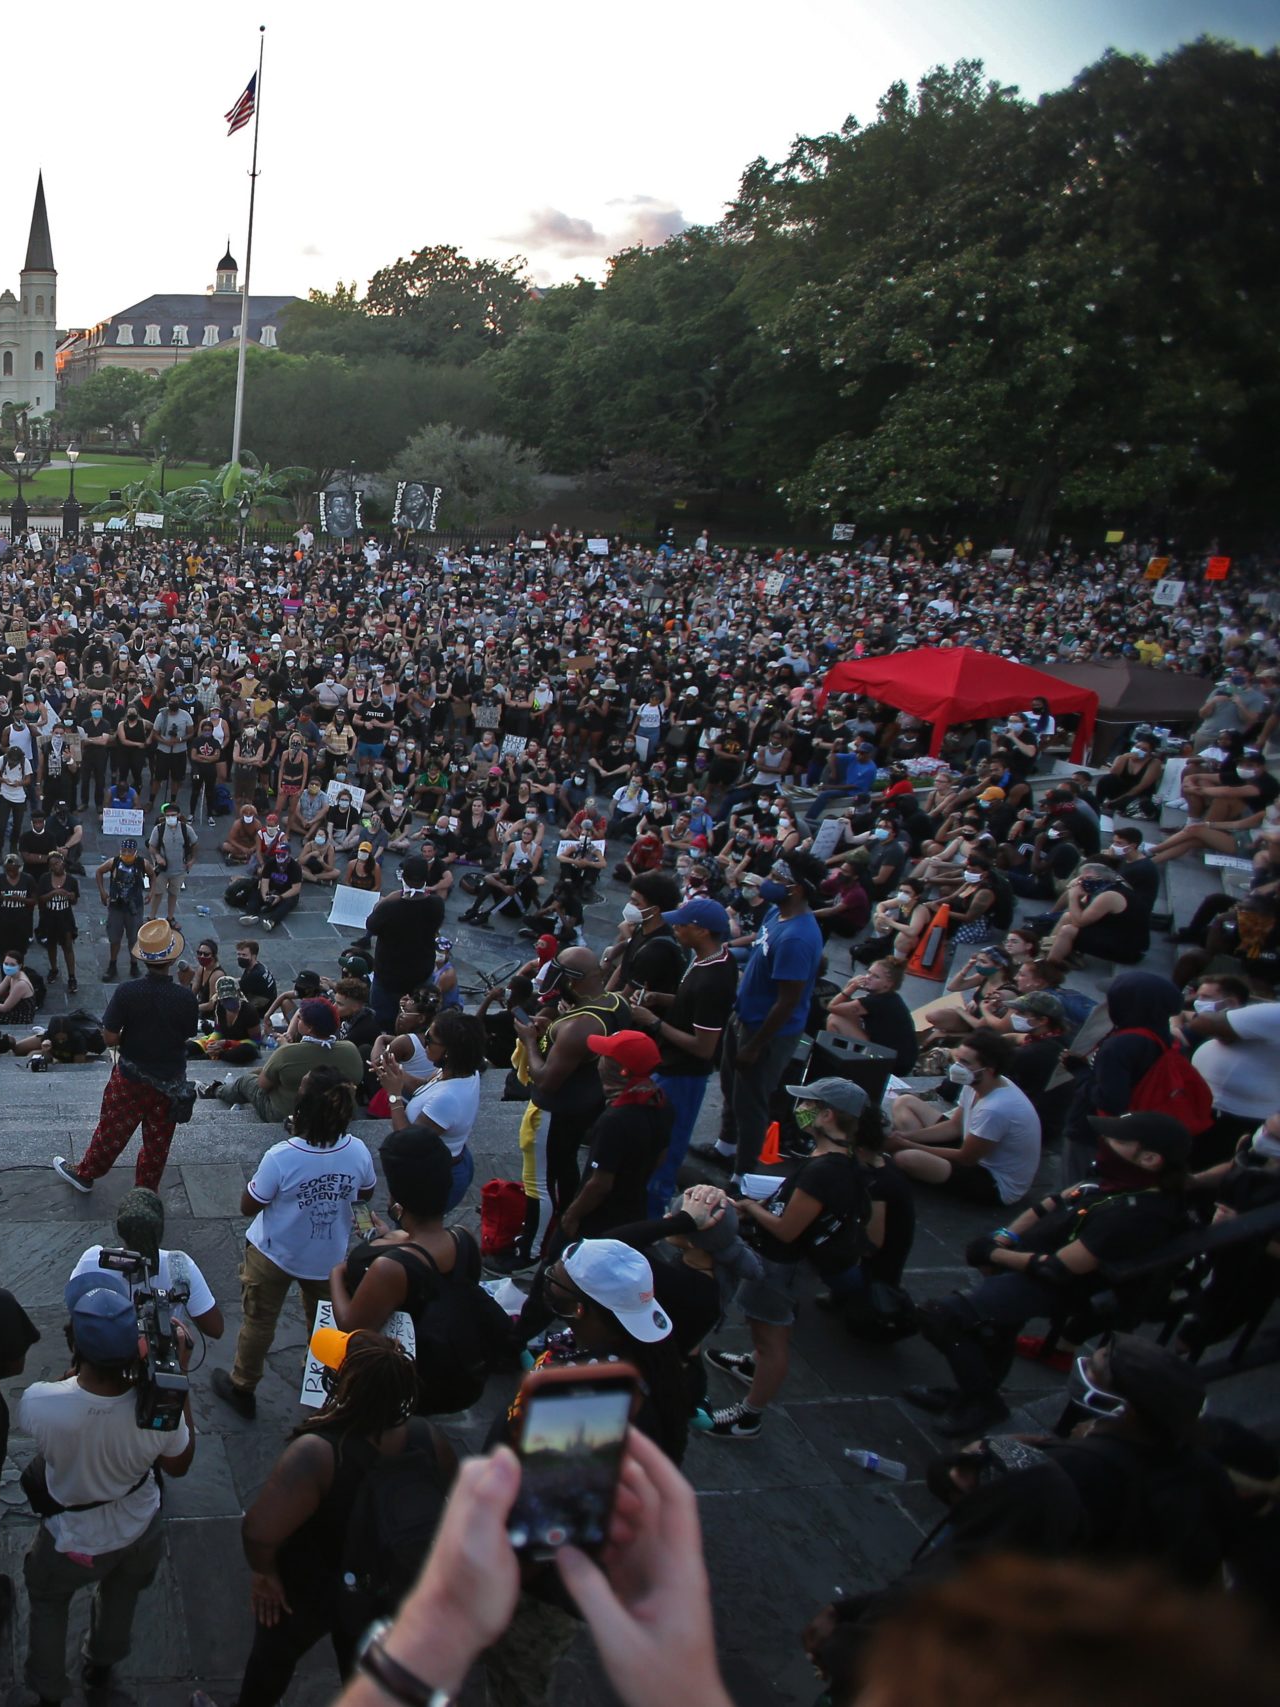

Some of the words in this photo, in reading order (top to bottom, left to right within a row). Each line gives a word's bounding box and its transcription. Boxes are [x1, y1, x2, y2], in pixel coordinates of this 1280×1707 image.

[319, 492, 328, 532] BREONNA
[354, 491, 363, 529] TAYLOR
[391, 481, 407, 524] MODESTO
[296, 1182, 335, 1200] FEARS
[297, 1191, 350, 1210] POTENTAL
[299, 1173, 356, 1192] SOCIETY
[305, 1304, 332, 1393] BRNA
